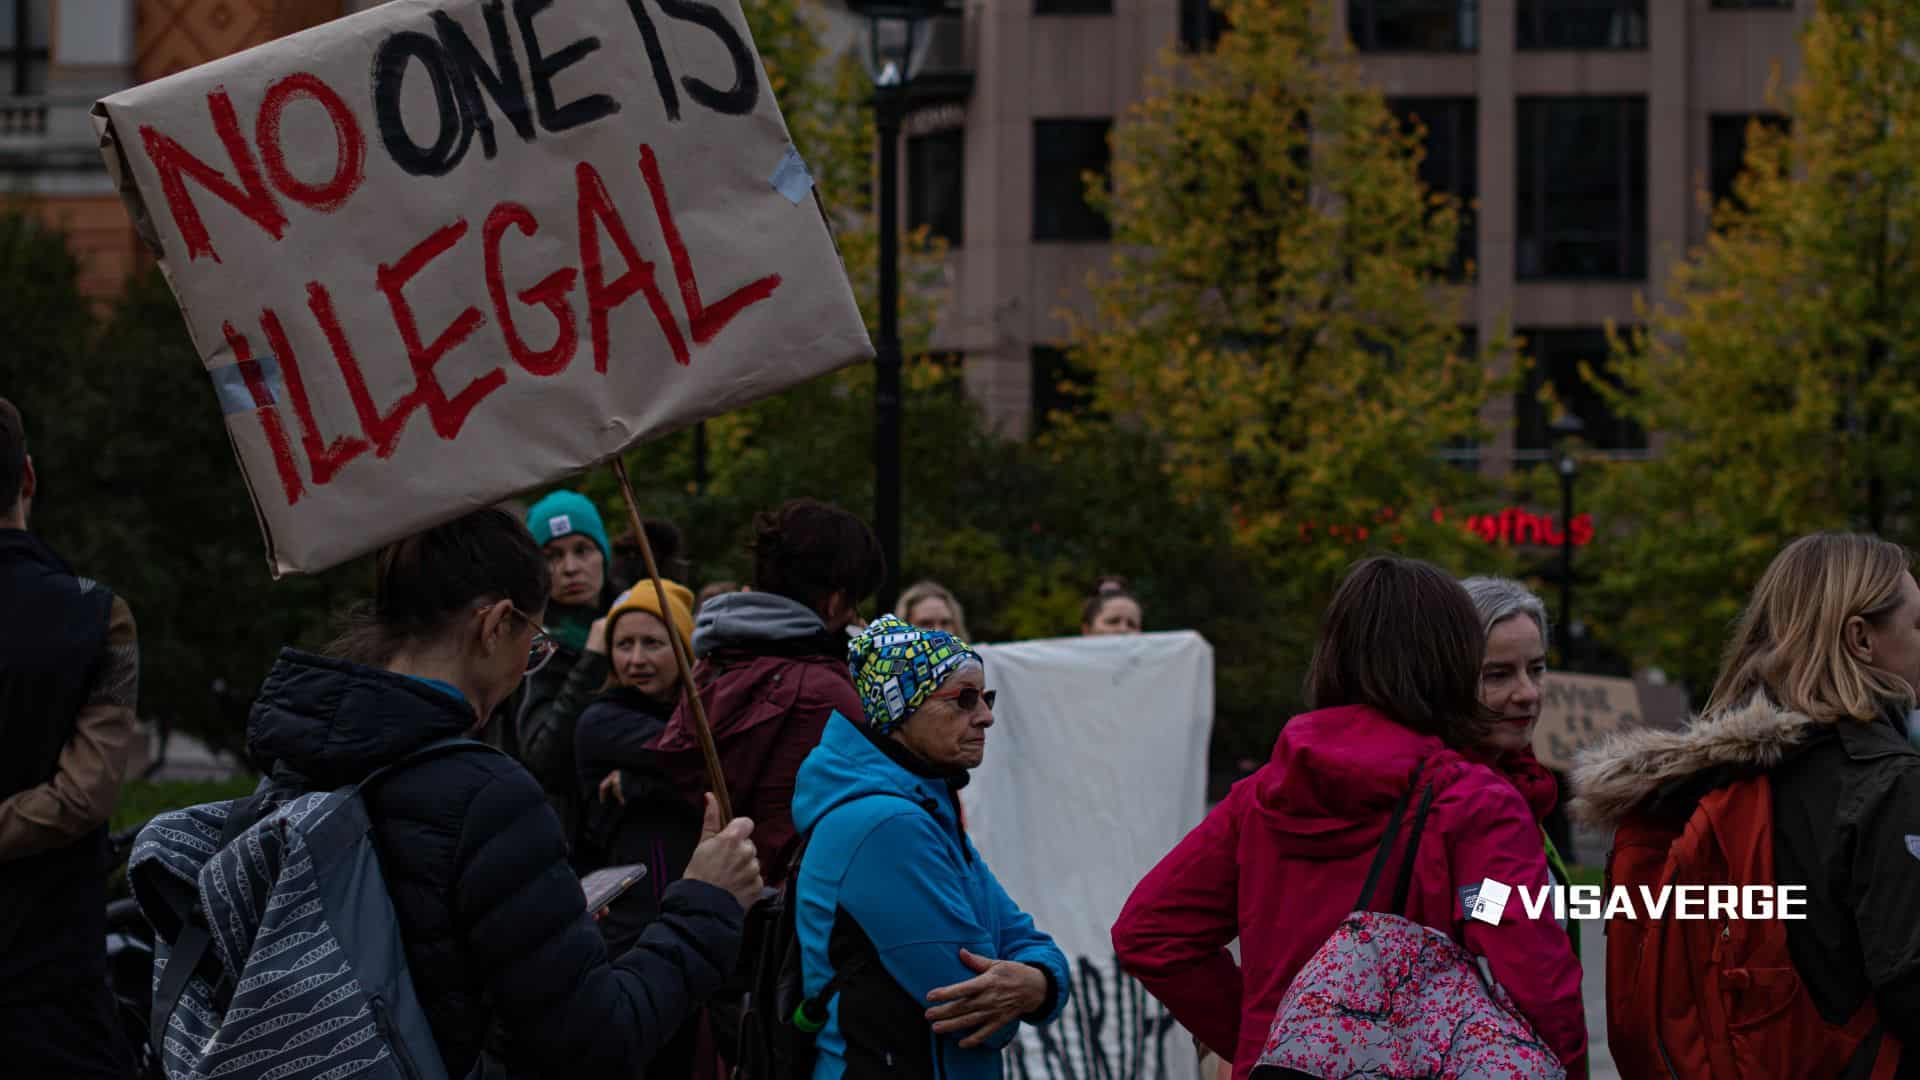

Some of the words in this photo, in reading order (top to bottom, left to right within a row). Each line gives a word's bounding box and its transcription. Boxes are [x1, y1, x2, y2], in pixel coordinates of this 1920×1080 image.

[139, 71, 366, 263] NO
[371, 0, 622, 177] ONE
[625, 0, 760, 121] IS
[223, 143, 782, 506] ILLEGAL
